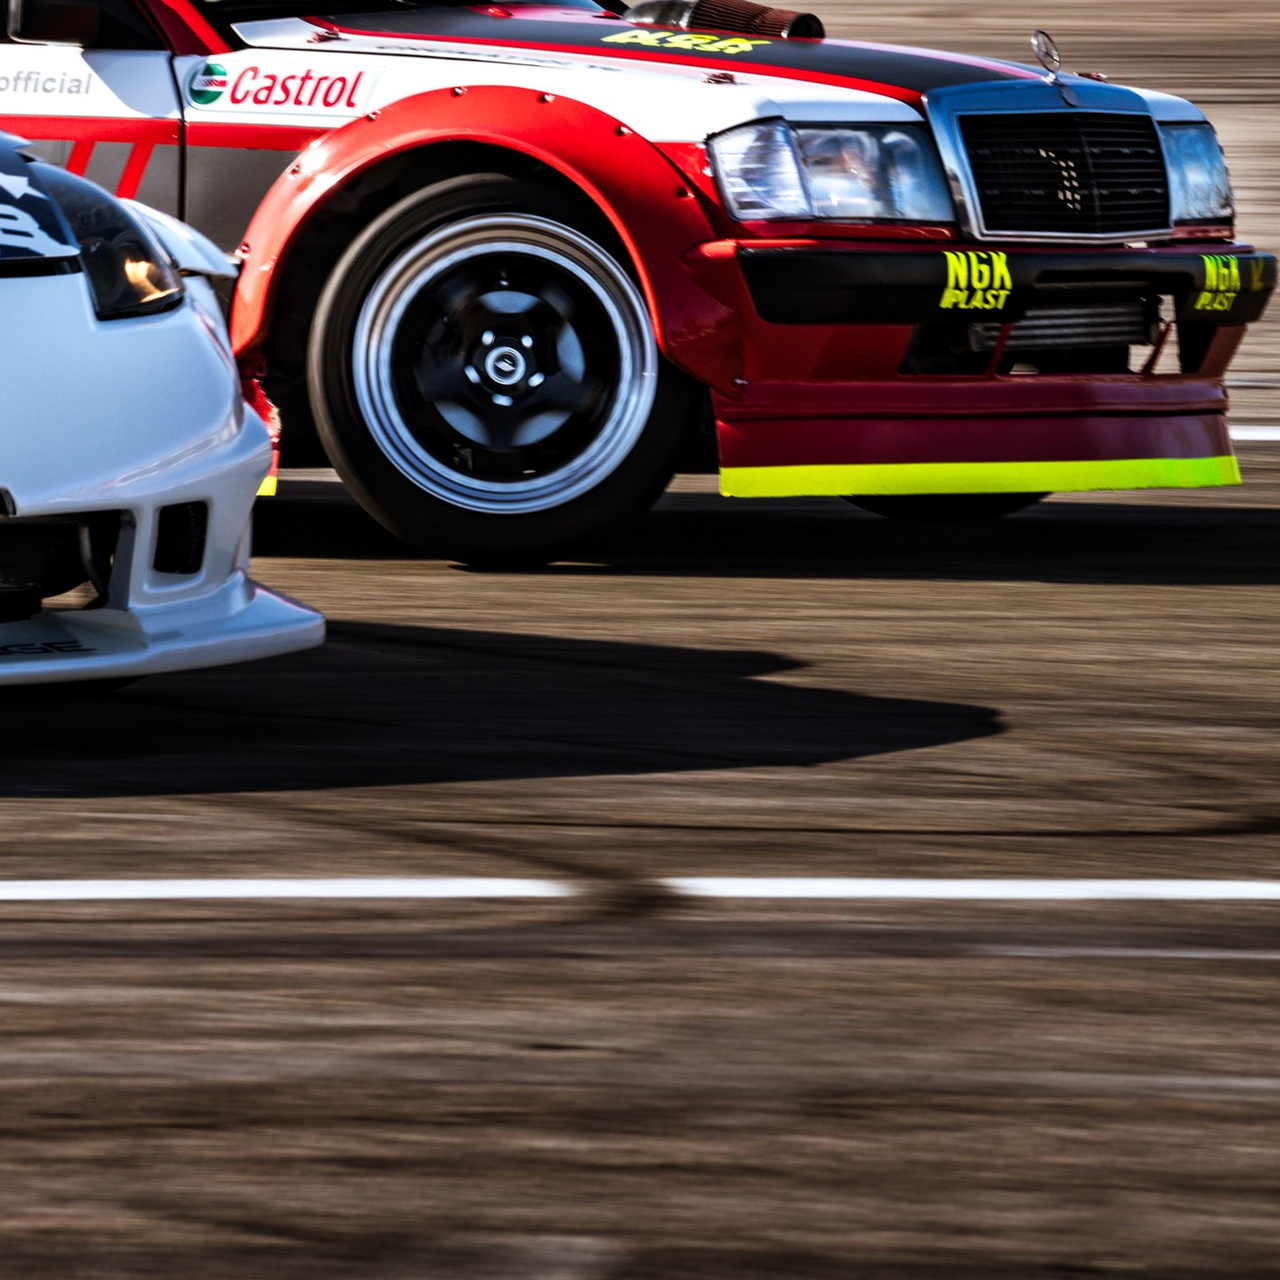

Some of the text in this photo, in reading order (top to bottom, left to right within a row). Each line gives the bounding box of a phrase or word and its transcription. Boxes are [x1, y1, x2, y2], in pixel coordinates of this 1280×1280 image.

[230, 65, 366, 108] Castrol
[943, 251, 1012, 290] NGK
[939, 288, 1011, 309] PLAST
